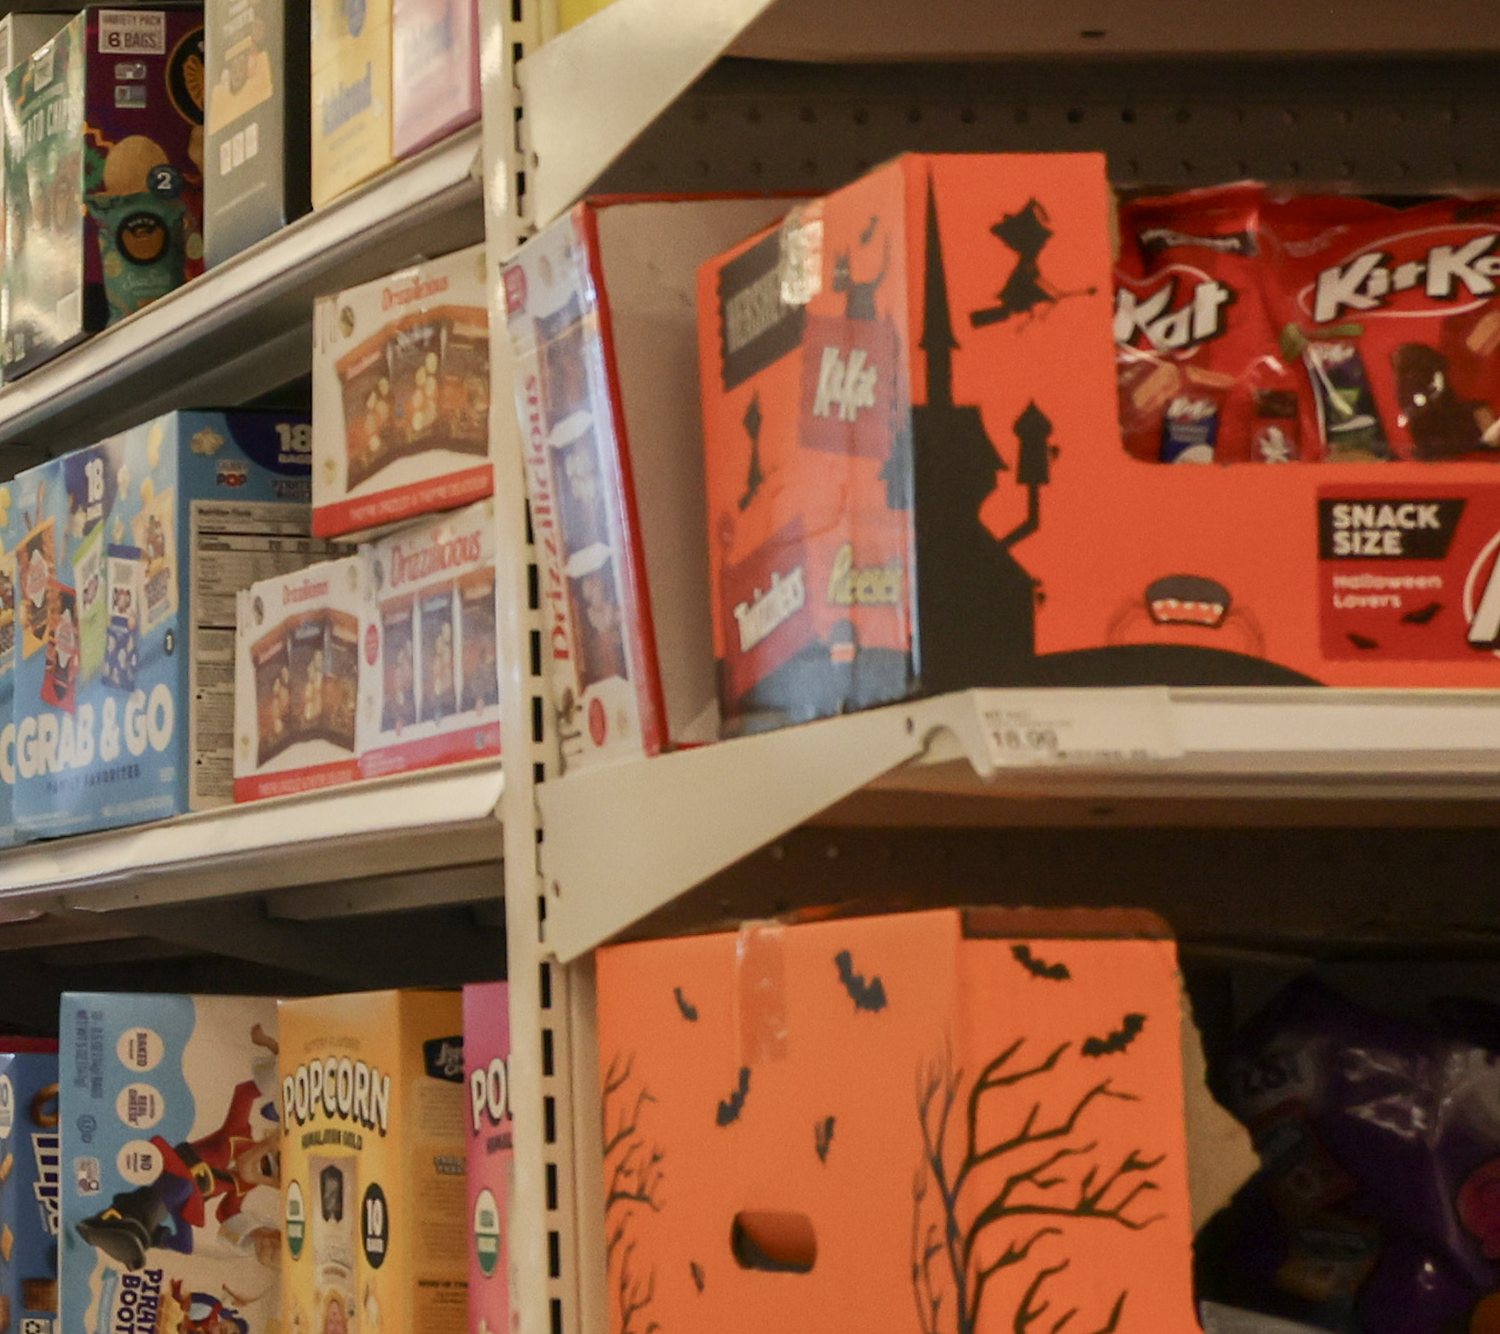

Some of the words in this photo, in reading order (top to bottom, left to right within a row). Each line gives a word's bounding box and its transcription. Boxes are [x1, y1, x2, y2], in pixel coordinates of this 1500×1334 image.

[140, 15, 161, 28] PACK
[107, 32, 120, 47] 6
[124, 31, 157, 47] BAGS
[157, 172, 171, 190] 2
[275, 423, 312, 454] 18
[85, 461, 103, 487] 18
[1332, 503, 1440, 530] SNACK
[1332, 530, 1404, 555] SIZE
[1332, 571, 1442, 591] Halloween
[1332, 590, 1403, 609] Lovers
[17, 705, 94, 779] GRAB
[100, 705, 120, 753] &
[124, 684, 174, 753] GO
[281, 1056, 391, 1136] POPCORN
[366, 1210, 382, 1236] 10
